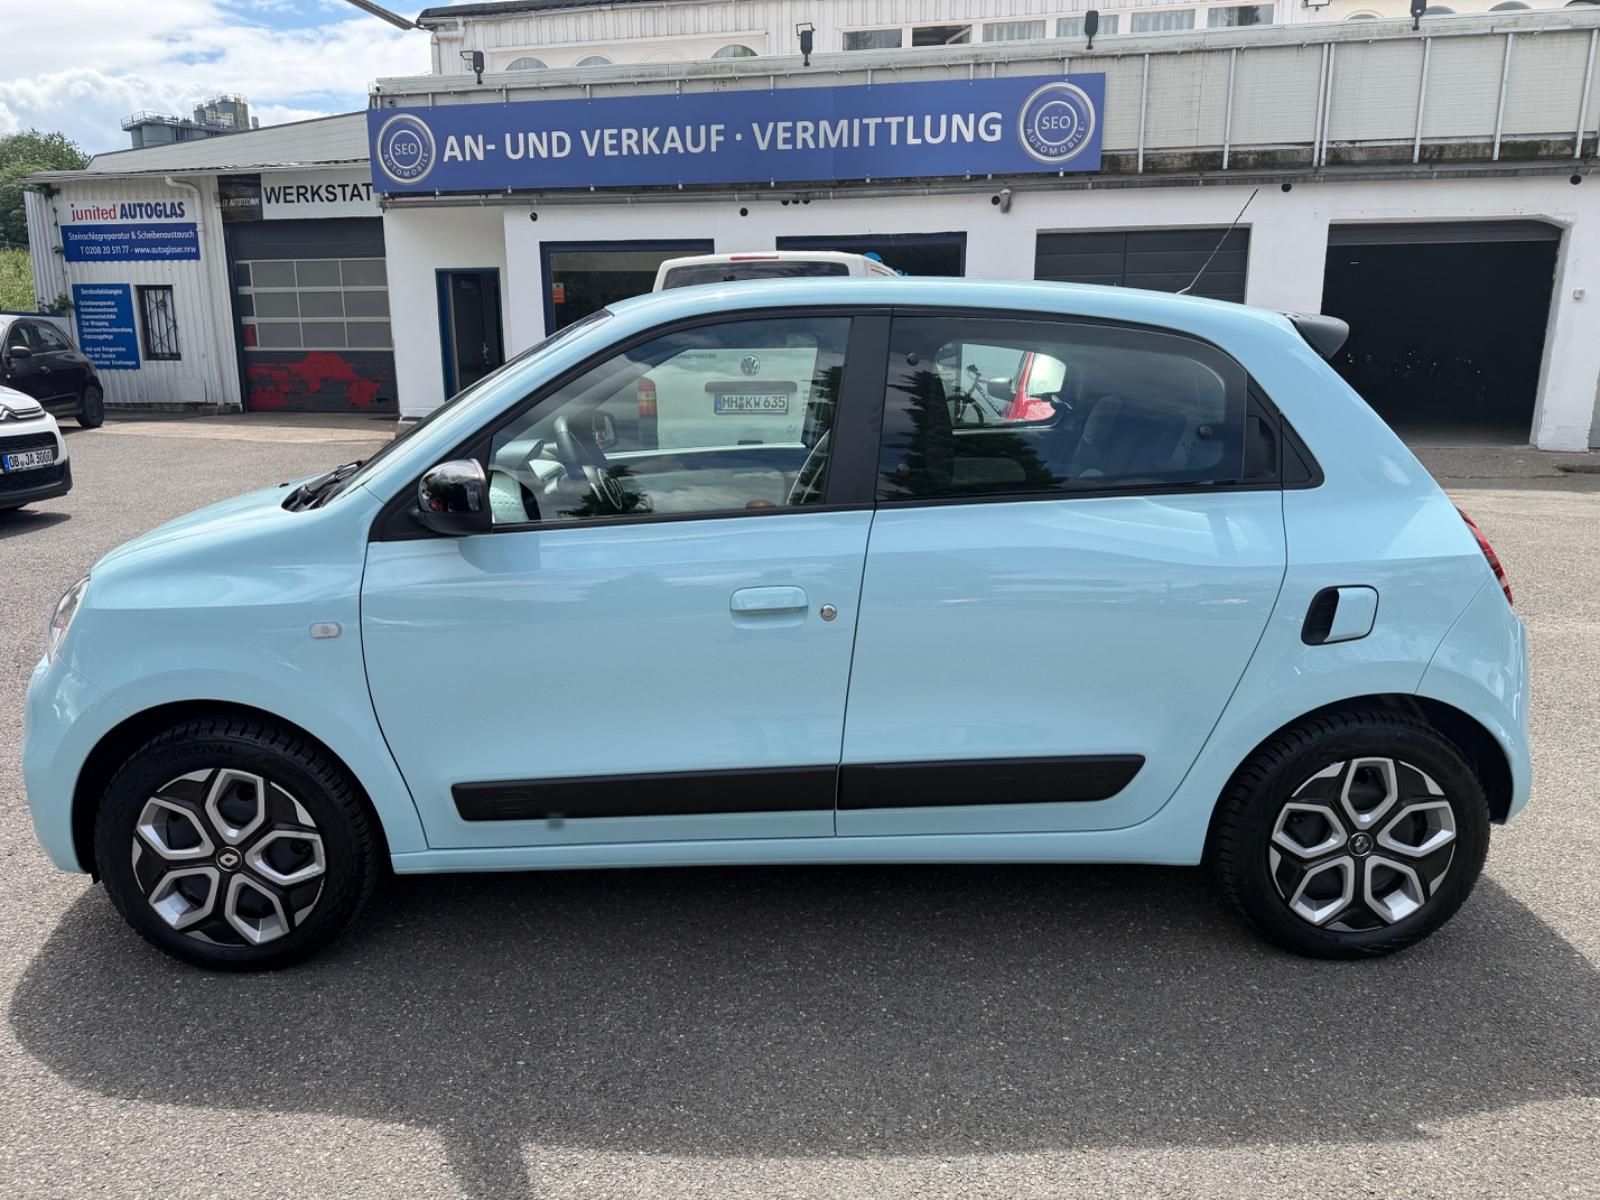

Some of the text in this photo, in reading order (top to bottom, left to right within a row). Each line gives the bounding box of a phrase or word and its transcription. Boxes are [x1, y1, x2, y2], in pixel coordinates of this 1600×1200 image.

[1041, 115, 1071, 130] SEO
[443, 111, 1004, 162] AN- UND VERKAUF VERMITTLUNG
[1026, 126, 1086, 155] AUTOMOBILE
[394, 142, 418, 156] SEO
[383, 152, 429, 177] AUTOMOBILE
[70, 201, 186, 222] junited AUTOGLAS
[130, 231, 137, 240] &
[137, 230, 195, 240] Scheibenaustausch
[722, 395, 786, 409] MH KW 635
